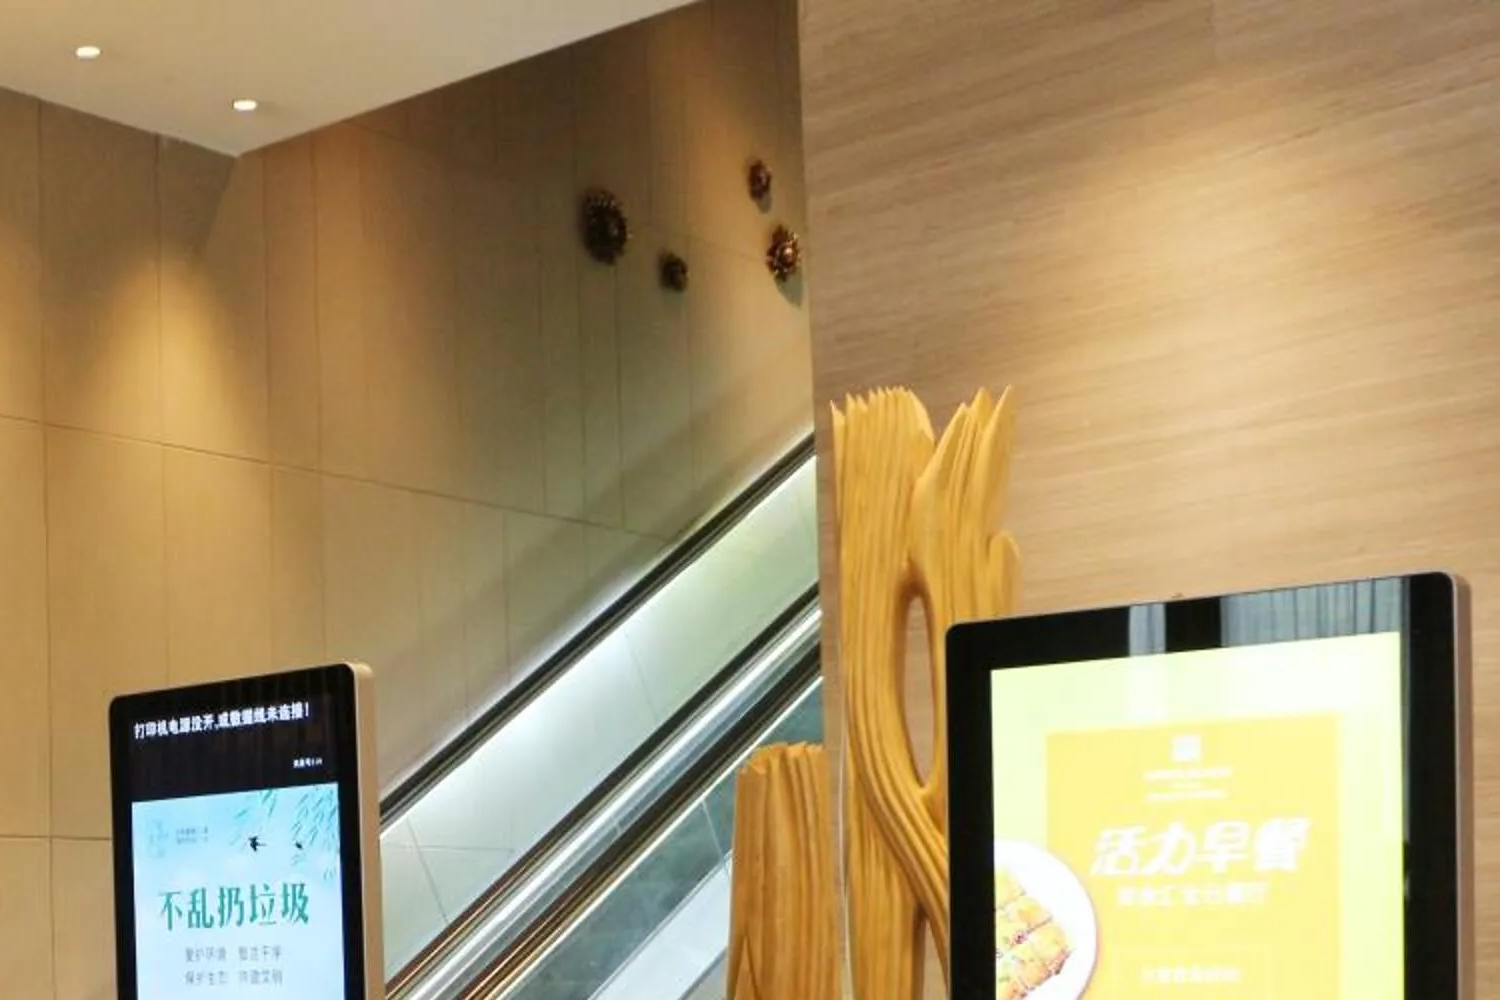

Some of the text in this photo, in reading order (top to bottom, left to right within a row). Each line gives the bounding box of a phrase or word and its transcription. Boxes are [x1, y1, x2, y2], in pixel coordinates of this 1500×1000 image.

[1089, 815, 1313, 876] 活力早餐
[158, 881, 310, 931] 不乱扔垃圾
